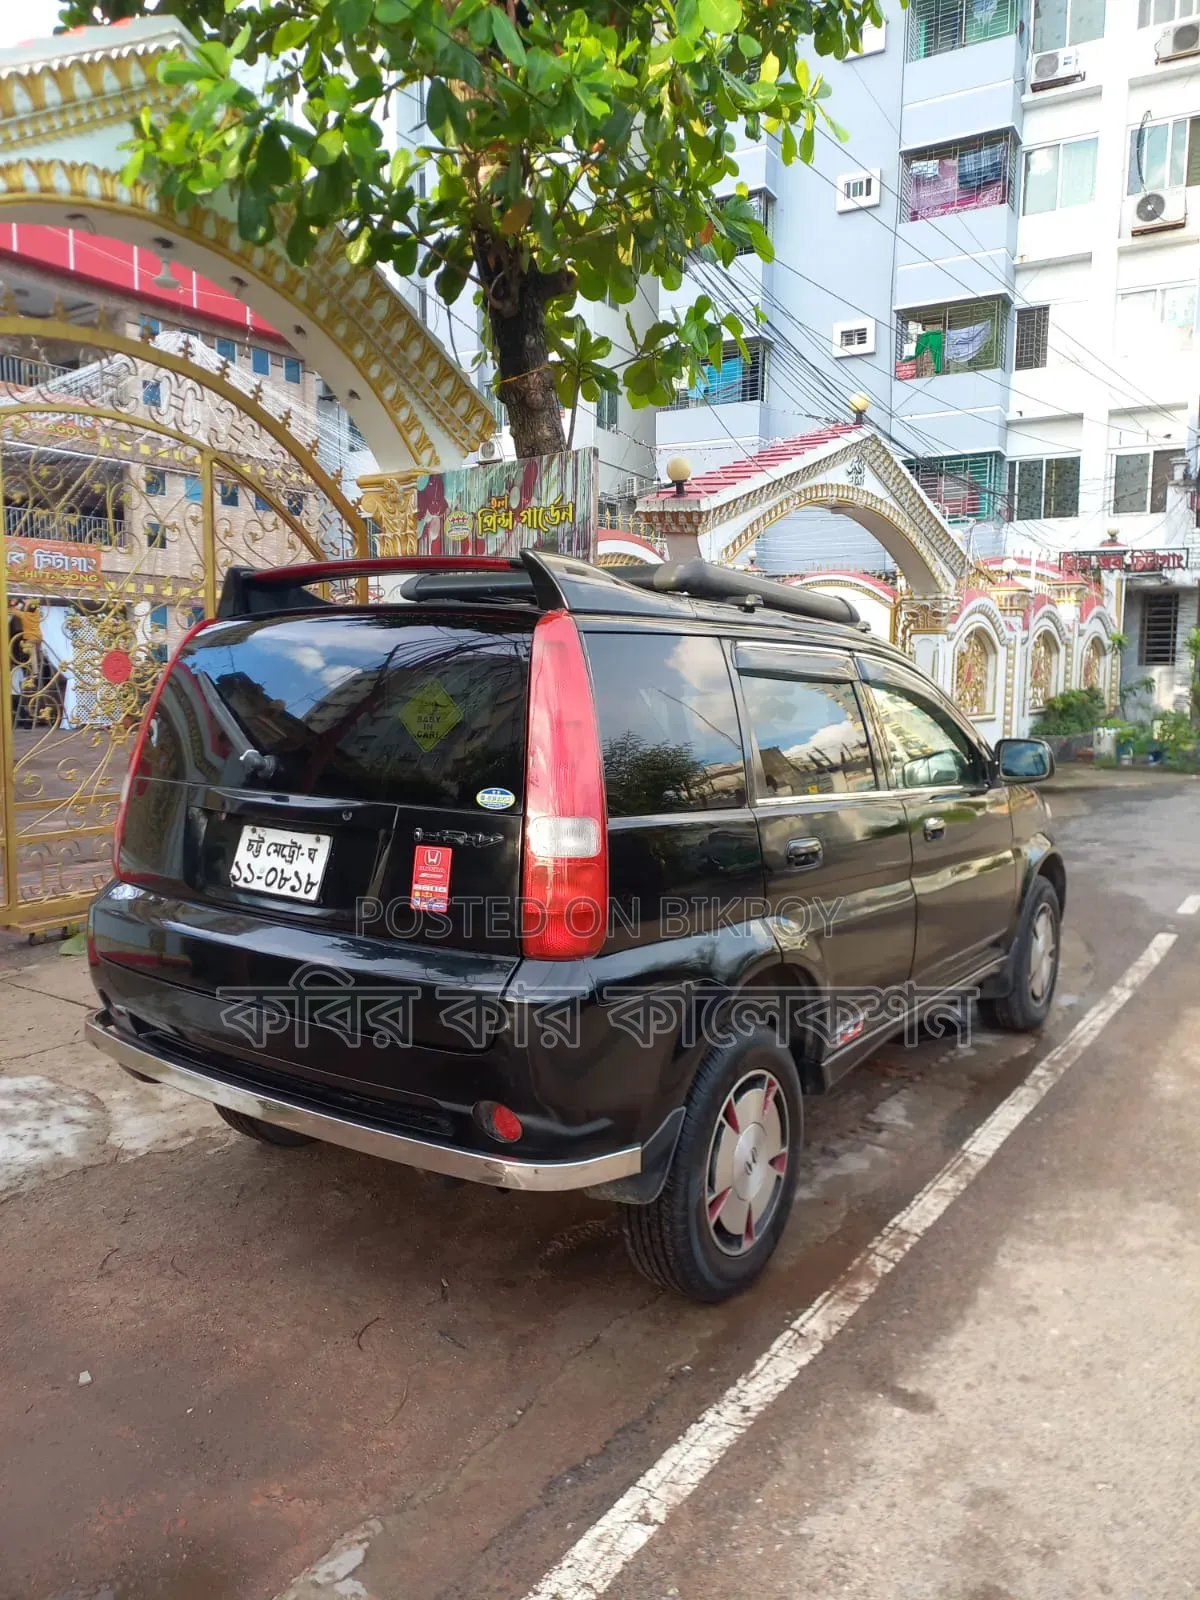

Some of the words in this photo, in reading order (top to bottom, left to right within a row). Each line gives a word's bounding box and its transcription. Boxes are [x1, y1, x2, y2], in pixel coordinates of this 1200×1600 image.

[519, 492, 574, 532] গার্ডেন
[423, 723, 433, 731] IN
[231, 861, 319, 894] ১১-০৮১৮
